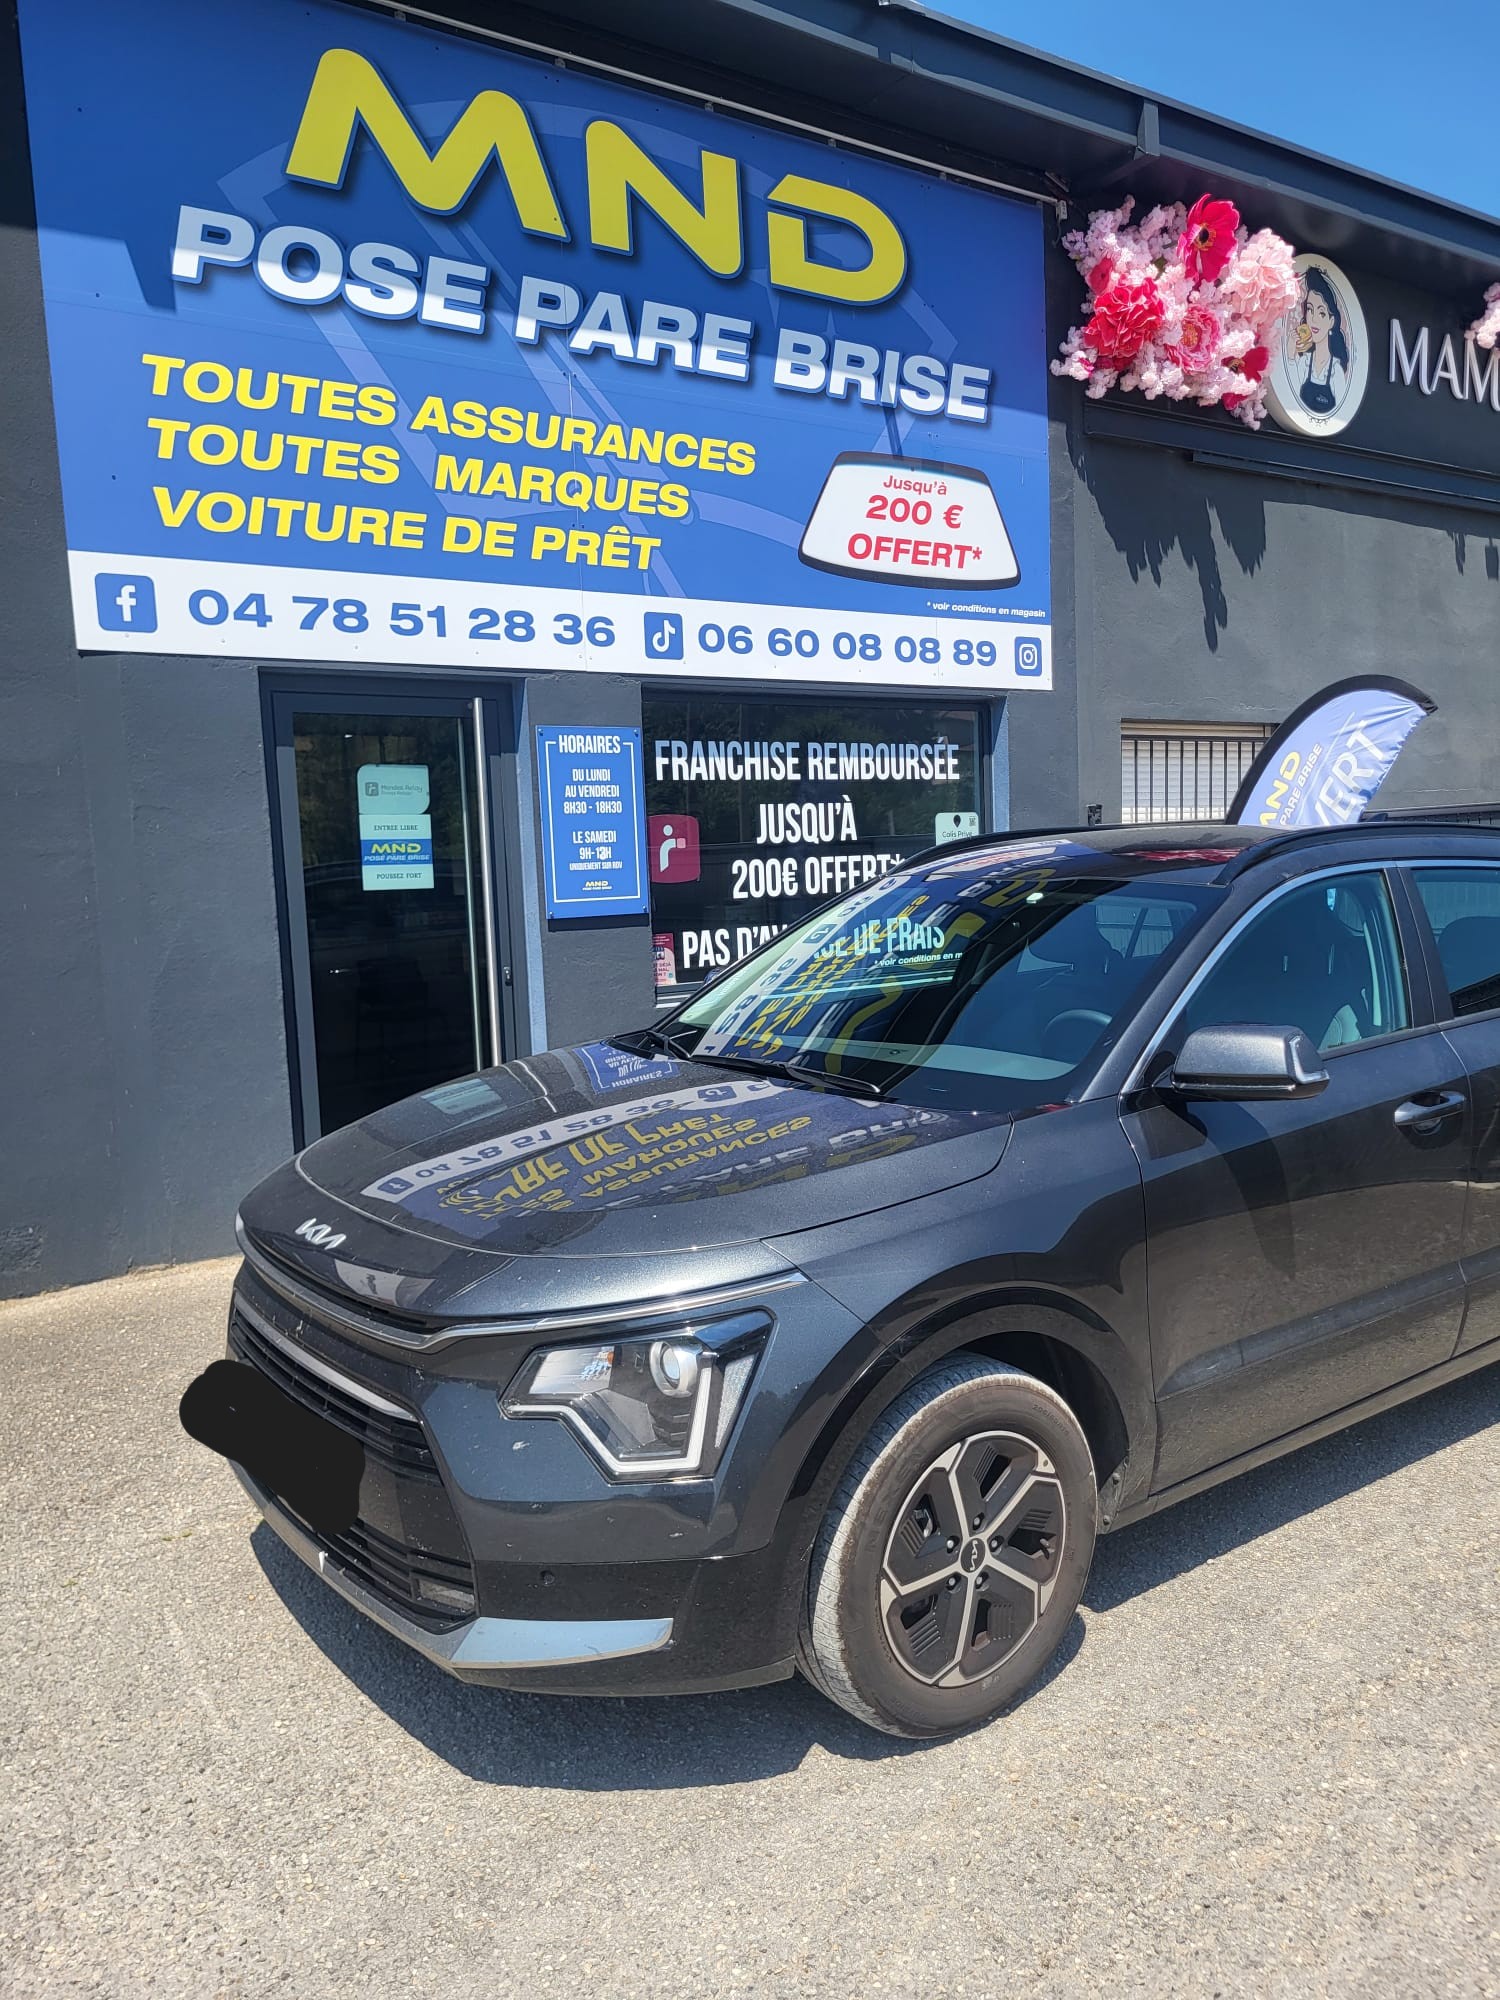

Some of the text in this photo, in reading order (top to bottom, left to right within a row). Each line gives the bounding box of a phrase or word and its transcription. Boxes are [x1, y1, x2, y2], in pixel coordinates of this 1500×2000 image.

[285, 48, 906, 302] MND
[171, 204, 990, 424] POSE PARE BRISE
[142, 352, 757, 477] TOUTES ASSURANCES
[147, 418, 690, 520] TOUTES MARQUES
[152, 487, 661, 571] VOITURE DE PRÊT
[867, 494, 963, 530] 200 €
[188, 588, 616, 648] 04 78 51 28 36
[932, 602, 949, 610] voir
[952, 603, 997, 614] conditions
[998, 607, 1009, 615] en
[1011, 609, 1046, 618] magasin
[698, 623, 997, 669] 06 60 08 08 89
[558, 734, 621, 754] HORAIRES
[655, 739, 960, 781] FRANCHISE REMBOURSÉE
[565, 784, 619, 798] AU VENDREDI
[572, 768, 611, 782] DU LUNDI
[1280, 743, 1322, 825] PARE BRISE
[563, 801, 587, 814] 8H30
[595, 800, 622, 814] 18H30
[757, 794, 858, 845] JUSQU'À
[371, 843, 422, 854] MND
[572, 830, 616, 844] LE SAMEDI
[731, 857, 799, 900] 200€
[682, 928, 731, 969] PAS
[879, 957, 897, 966] voir
[898, 953, 941, 965] conditions
[942, 952, 953, 961] en
